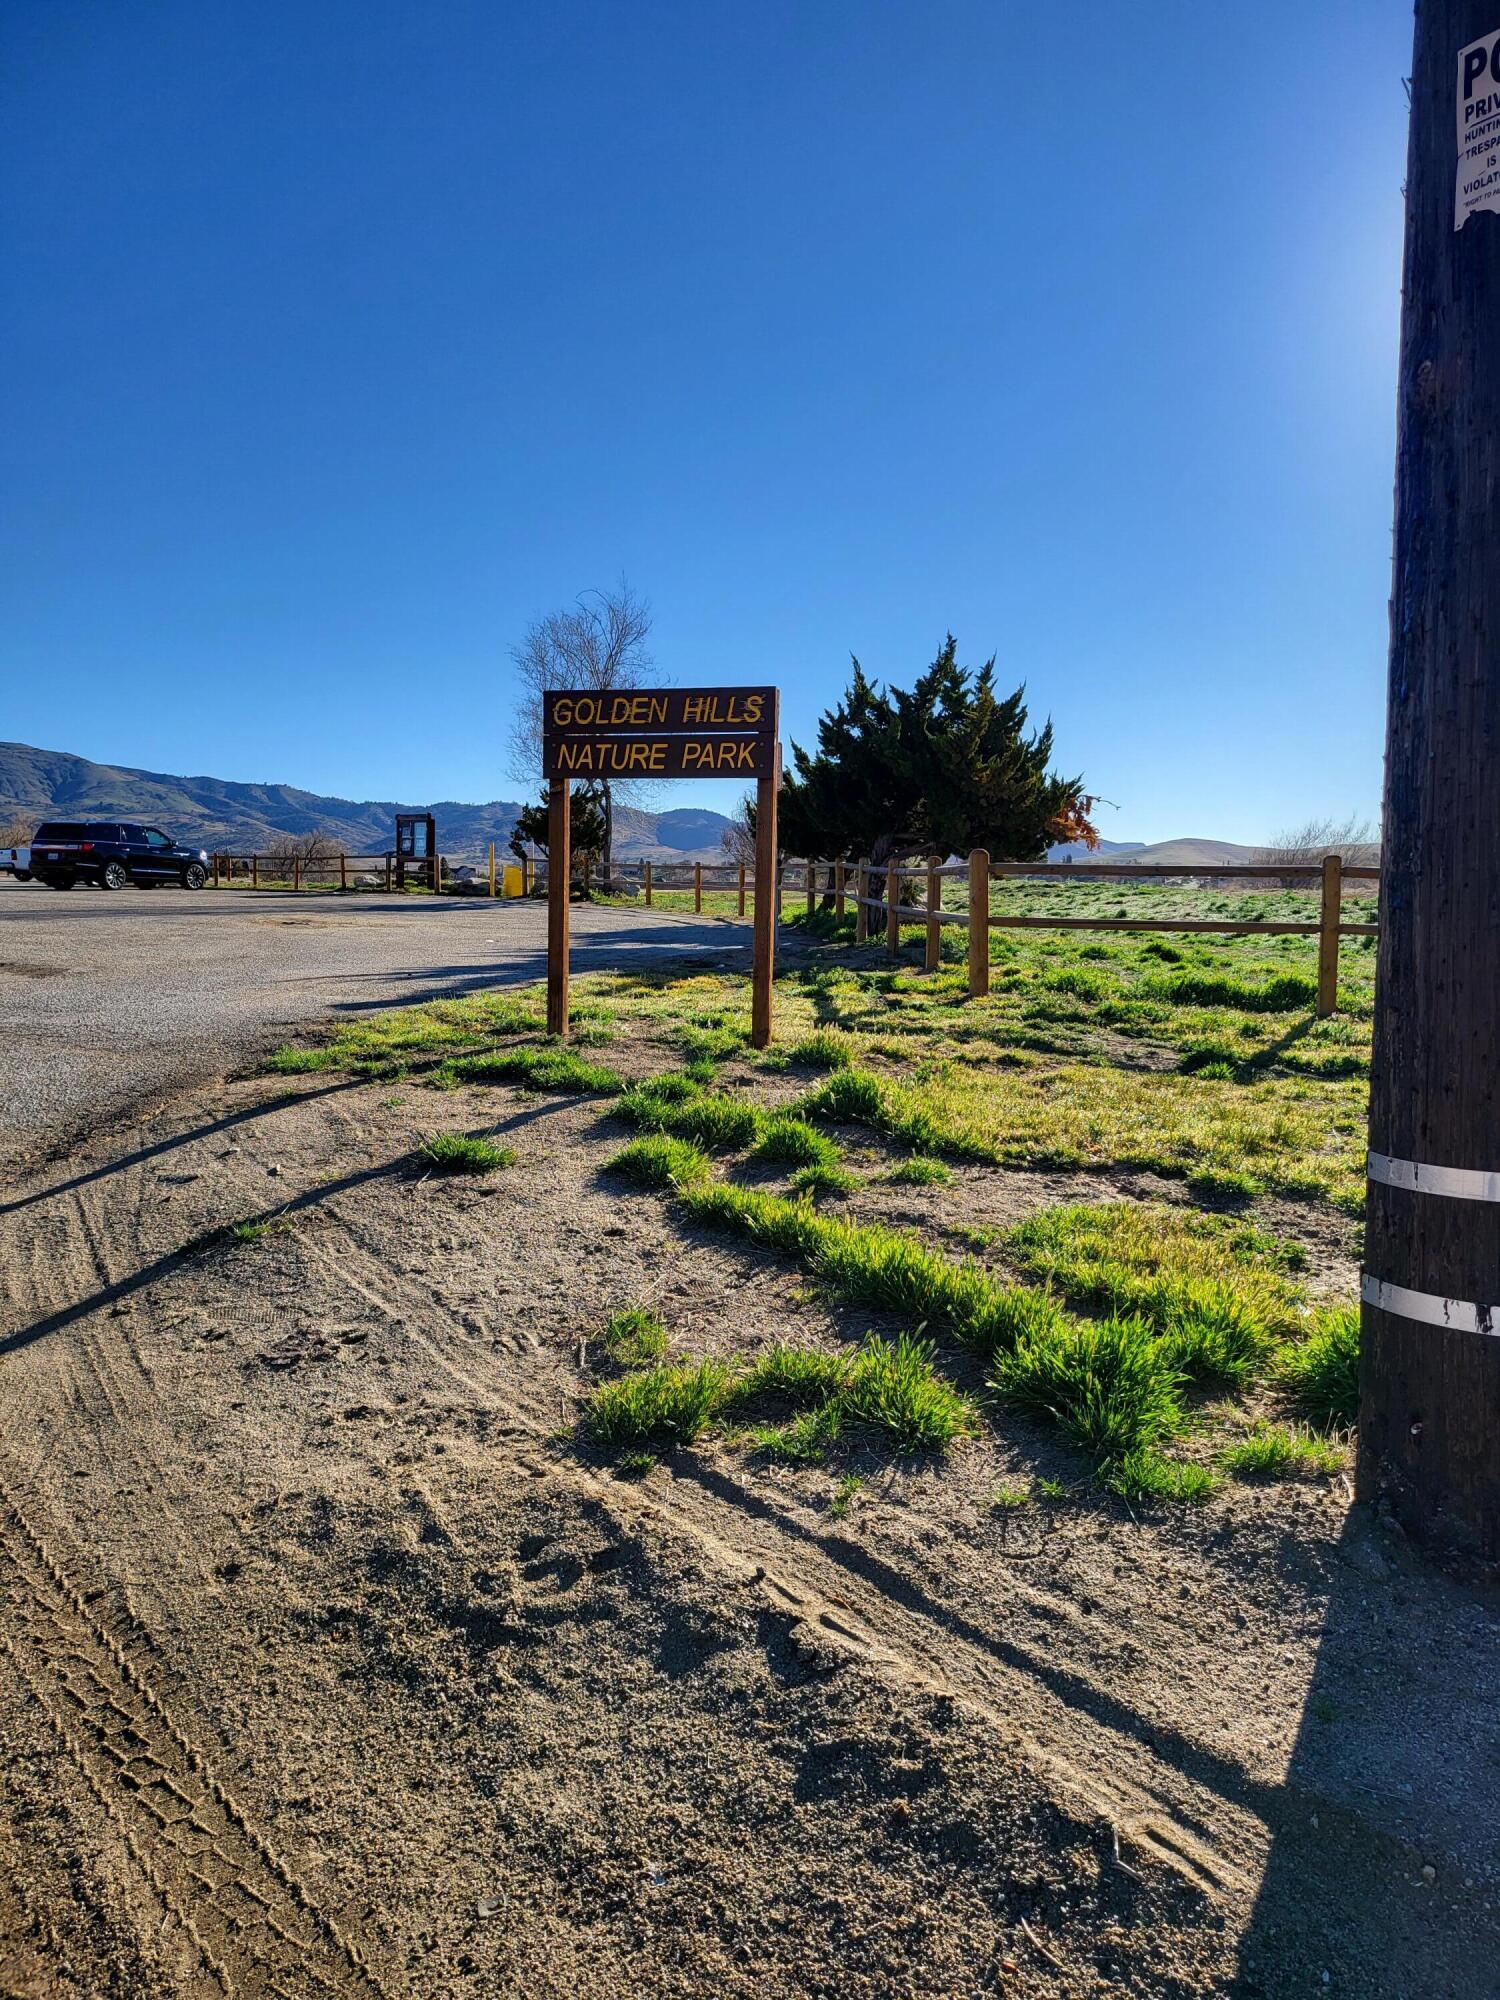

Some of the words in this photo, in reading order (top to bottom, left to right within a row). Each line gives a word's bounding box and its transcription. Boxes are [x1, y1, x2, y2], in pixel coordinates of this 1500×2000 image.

[1487, 155, 1496, 168] IS
[1464, 171, 1500, 194] VIOLAT
[553, 697, 668, 725] GOLDEN
[683, 695, 765, 724] HILLS
[557, 743, 668, 770] NATURE
[682, 742, 756, 769] PARK
